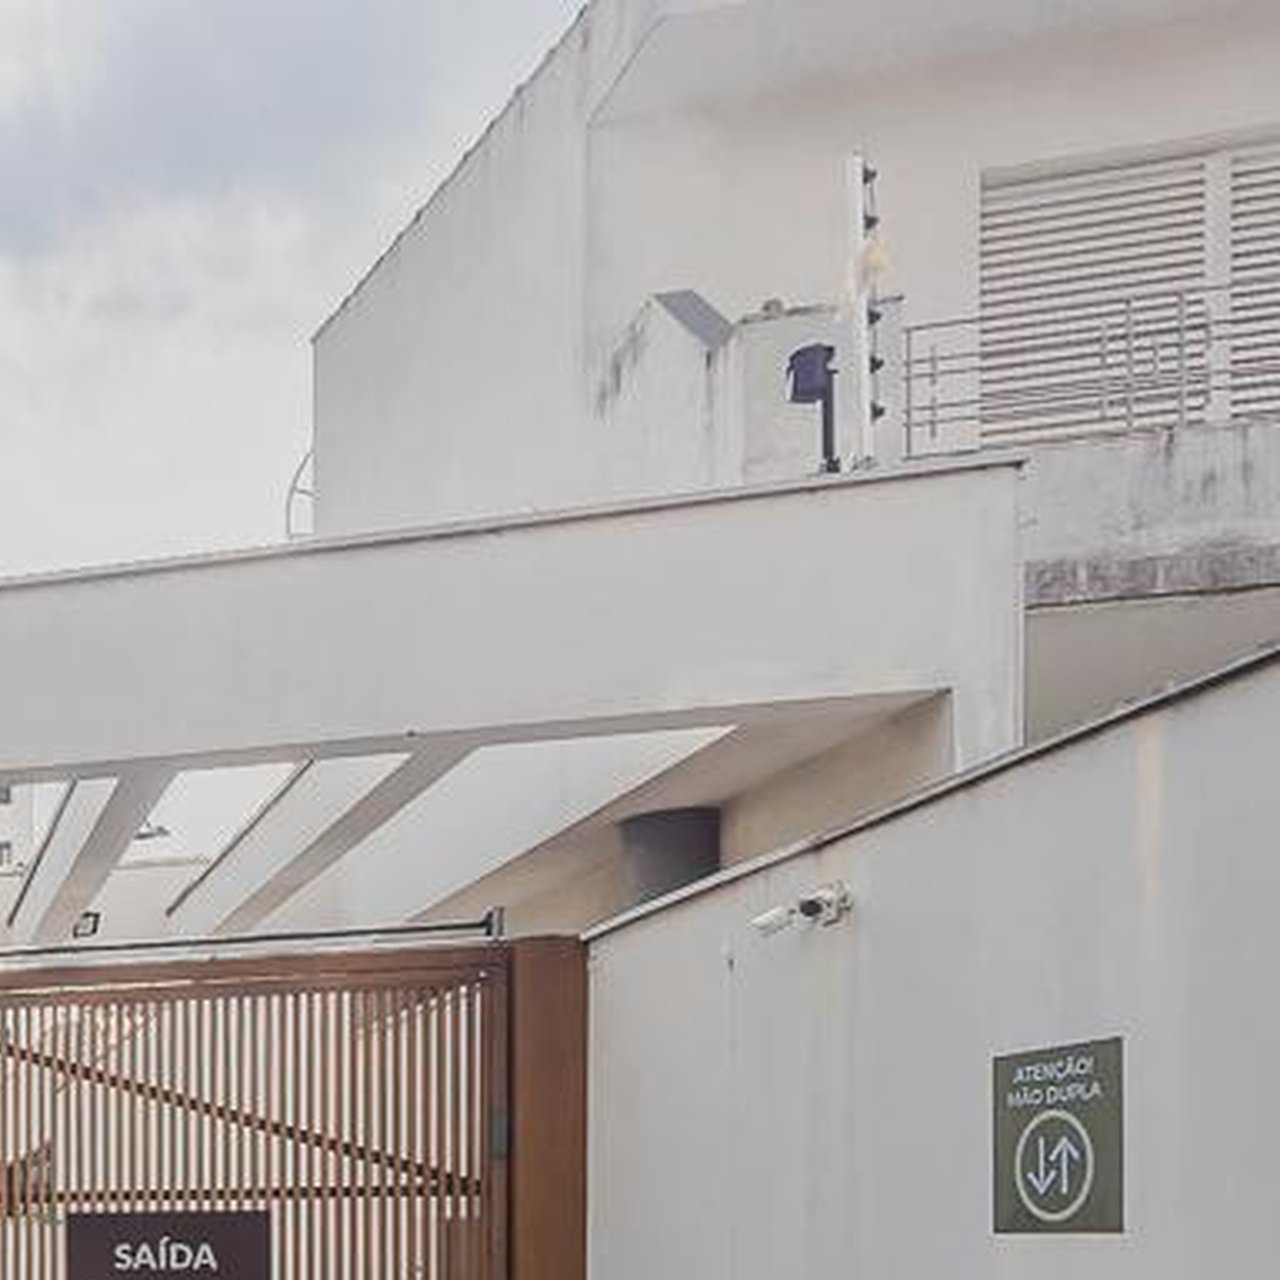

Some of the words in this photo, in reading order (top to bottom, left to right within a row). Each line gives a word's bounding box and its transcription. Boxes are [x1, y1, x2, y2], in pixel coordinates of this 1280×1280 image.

[1012, 1055, 1095, 1085] ATENÇÃO!
[1006, 1086, 1044, 1108] MÃO
[1046, 1081, 1104, 1104] DUPLA
[113, 1235, 218, 1270] SAÍDA
